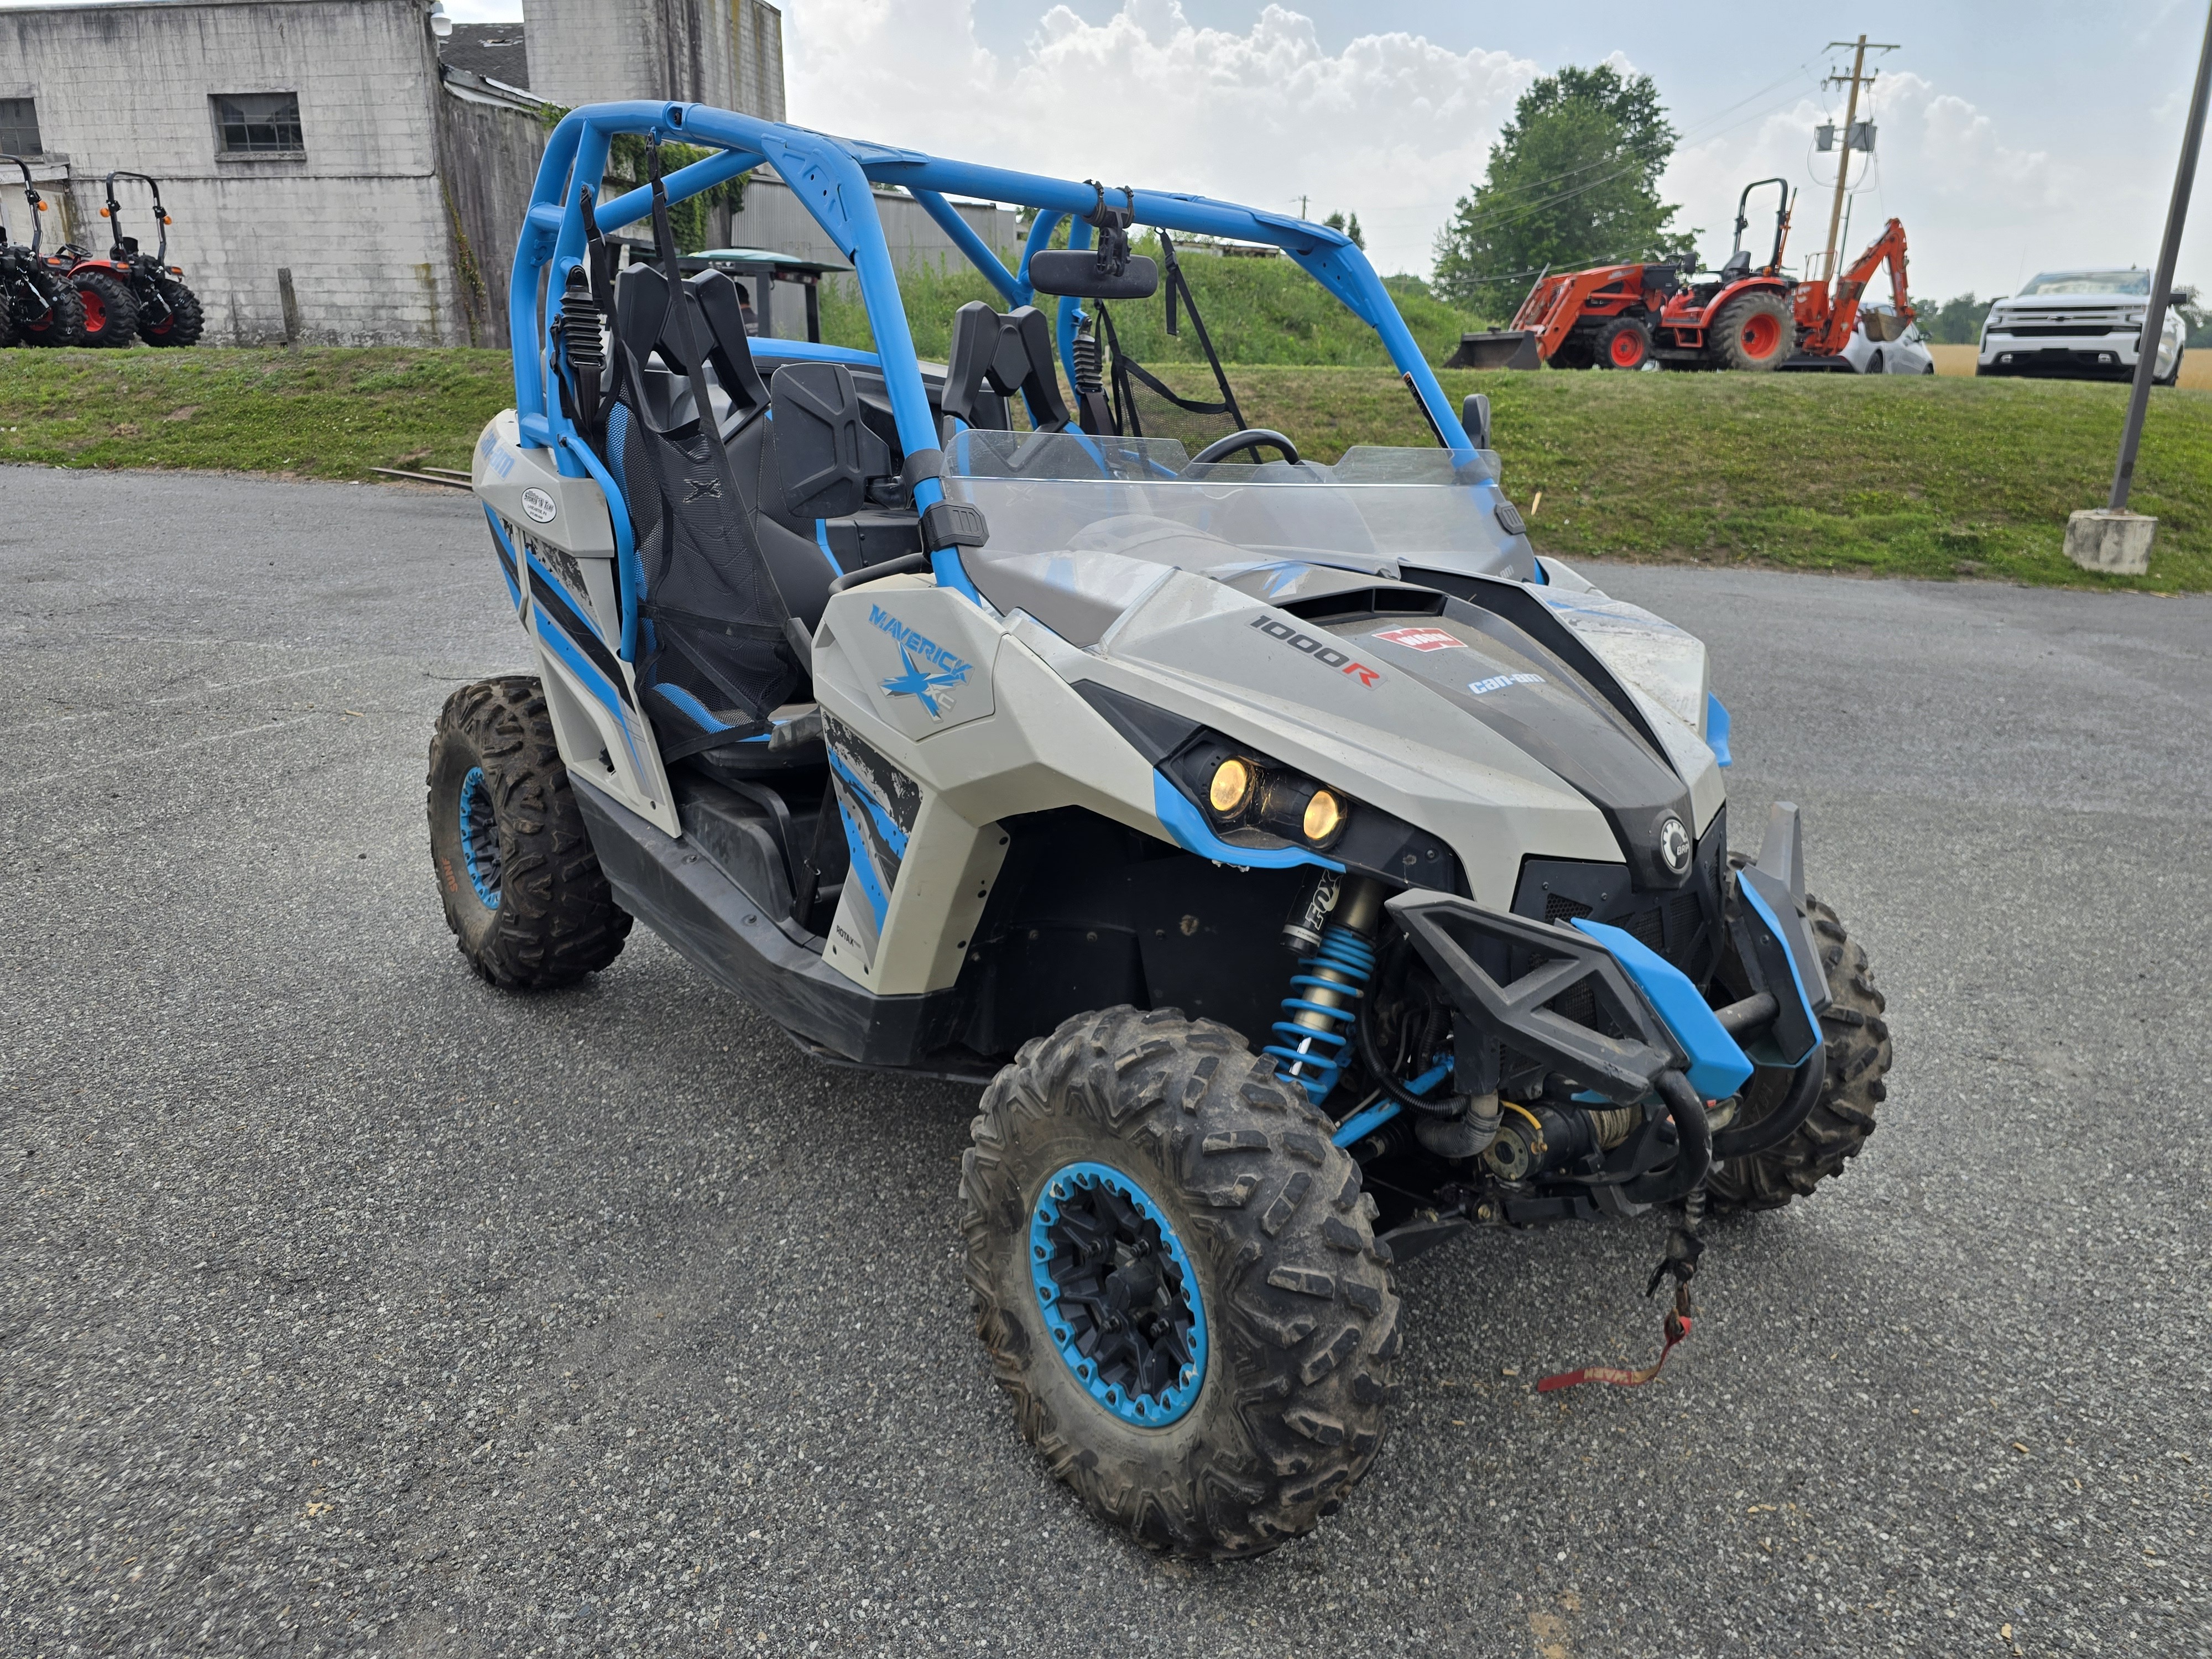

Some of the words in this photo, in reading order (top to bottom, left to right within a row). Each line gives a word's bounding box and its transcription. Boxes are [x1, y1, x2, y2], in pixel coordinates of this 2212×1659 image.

[869, 604, 974, 684] MAVERICK
[1397, 633, 1453, 645] WARN
[1250, 615, 1380, 687] 1000R
[1468, 672, 1546, 695] can-am
[1677, 843, 1689, 856] BRP
[1305, 869, 1344, 931] FOX
[837, 925, 854, 947] ROTAX
